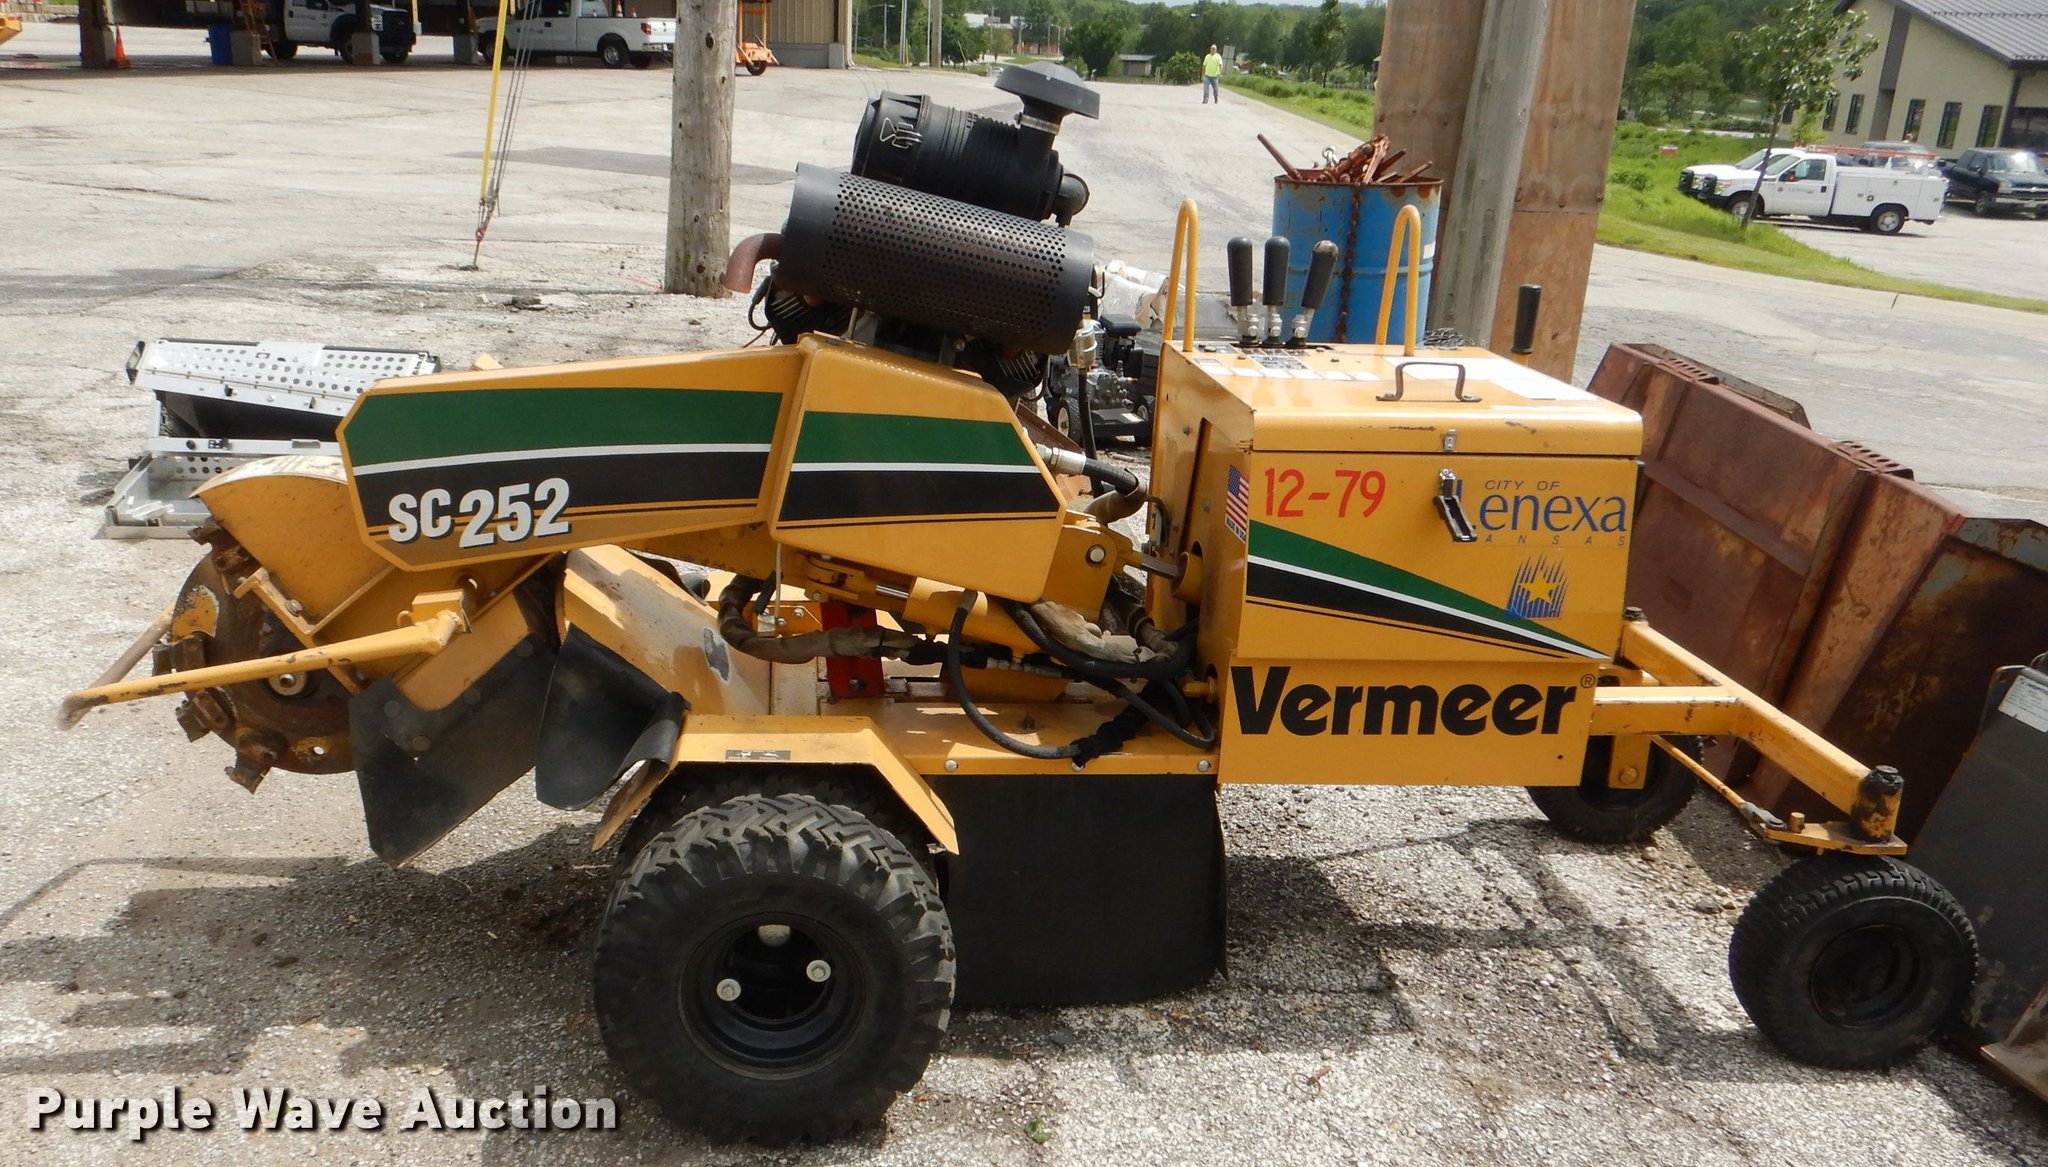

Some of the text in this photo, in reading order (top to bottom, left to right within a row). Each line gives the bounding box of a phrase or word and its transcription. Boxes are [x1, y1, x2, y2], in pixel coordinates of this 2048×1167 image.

[1484, 479, 1561, 491] CITY OF
[1264, 467, 1387, 518] 12-79
[1484, 535, 1627, 547] ANSAS
